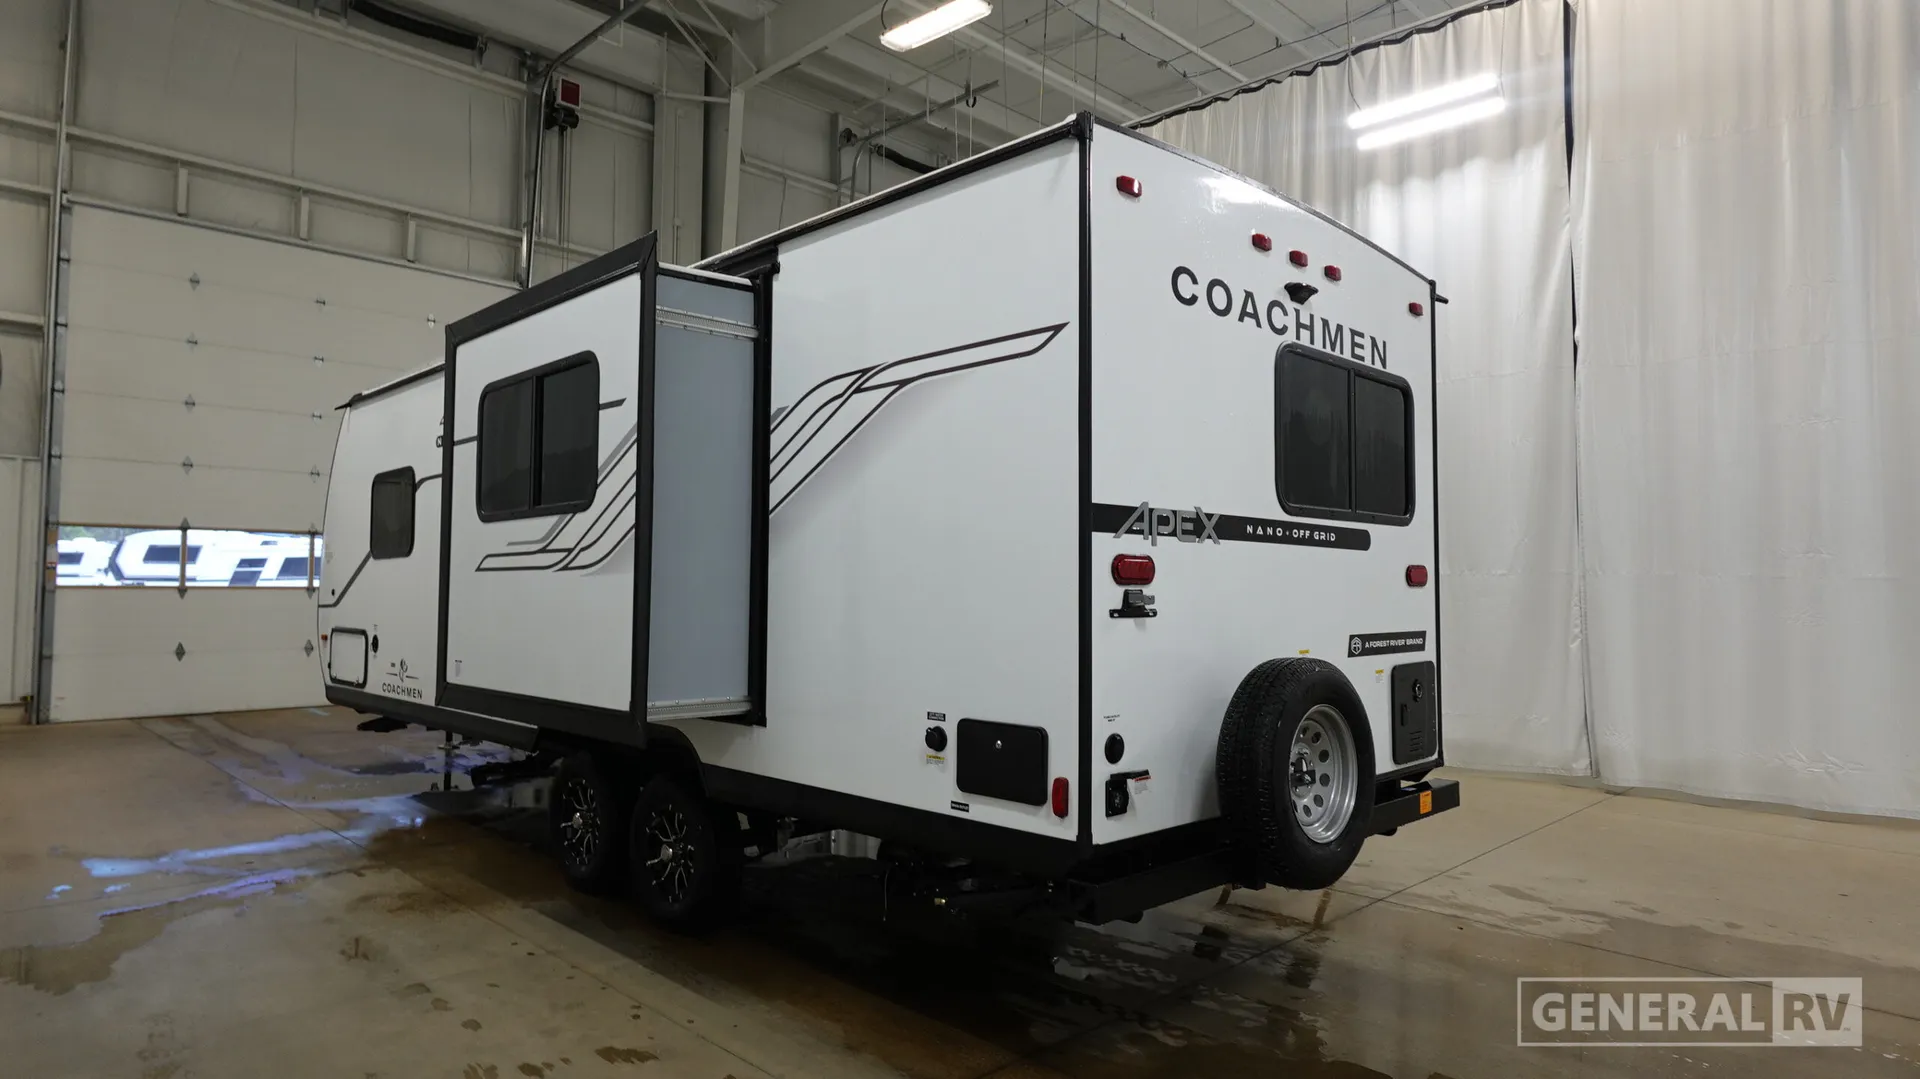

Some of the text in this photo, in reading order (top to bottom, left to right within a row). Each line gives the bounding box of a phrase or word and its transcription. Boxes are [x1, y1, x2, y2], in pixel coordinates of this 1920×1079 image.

[1171, 265, 1387, 369] COACHMEN
[1113, 501, 1221, 547] APEX
[1246, 524, 1336, 542] NANO OFF GRID
[1369, 639, 1390, 648] FOREST
[1406, 637, 1424, 645] BRAND
[382, 682, 423, 699] COACHMEN
